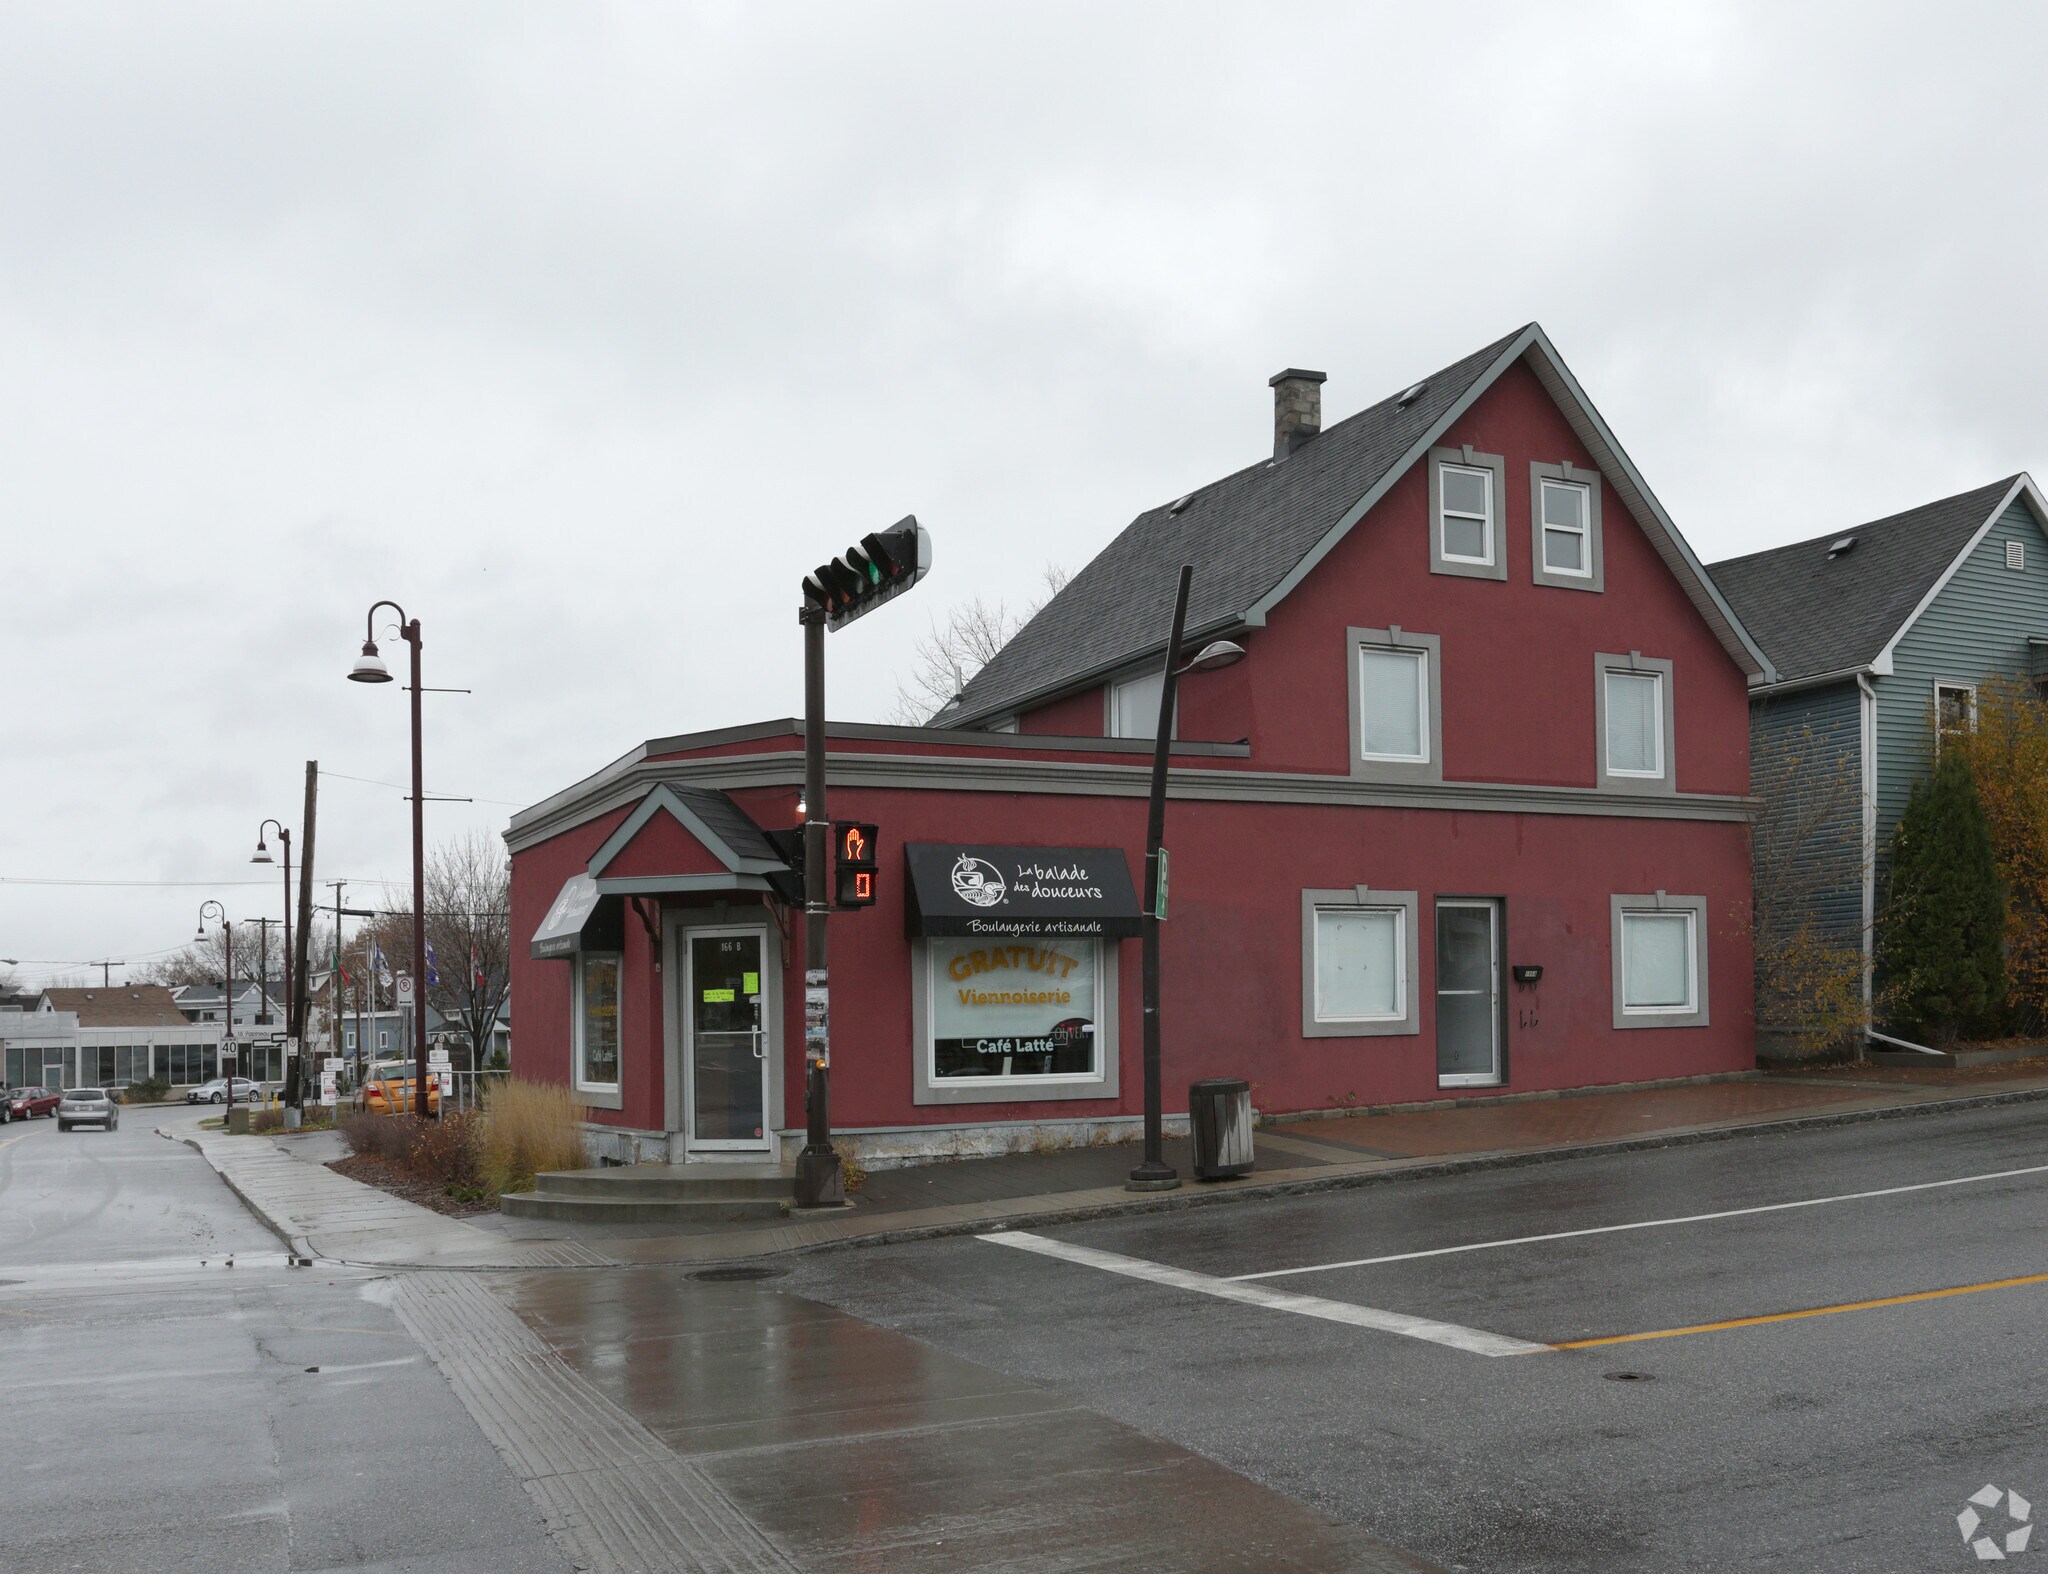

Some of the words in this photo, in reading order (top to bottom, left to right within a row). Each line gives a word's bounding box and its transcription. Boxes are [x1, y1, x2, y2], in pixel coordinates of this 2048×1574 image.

[1017, 864, 1033, 877] La
[1034, 863, 1089, 880] balade
[1013, 881, 1030, 892] des
[1031, 881, 1102, 899] douceurs
[966, 919, 1041, 937] Boulangerie
[1045, 921, 1102, 932] artisanale
[721, 942, 733, 952] 166
[736, 941, 742, 951] B
[948, 944, 1079, 981] GRATUIT
[958, 988, 1071, 1005] Viennoiserie
[222, 1042, 237, 1053] 40
[976, 1039, 1012, 1054] Café
[1016, 1038, 1054, 1053] Latté
